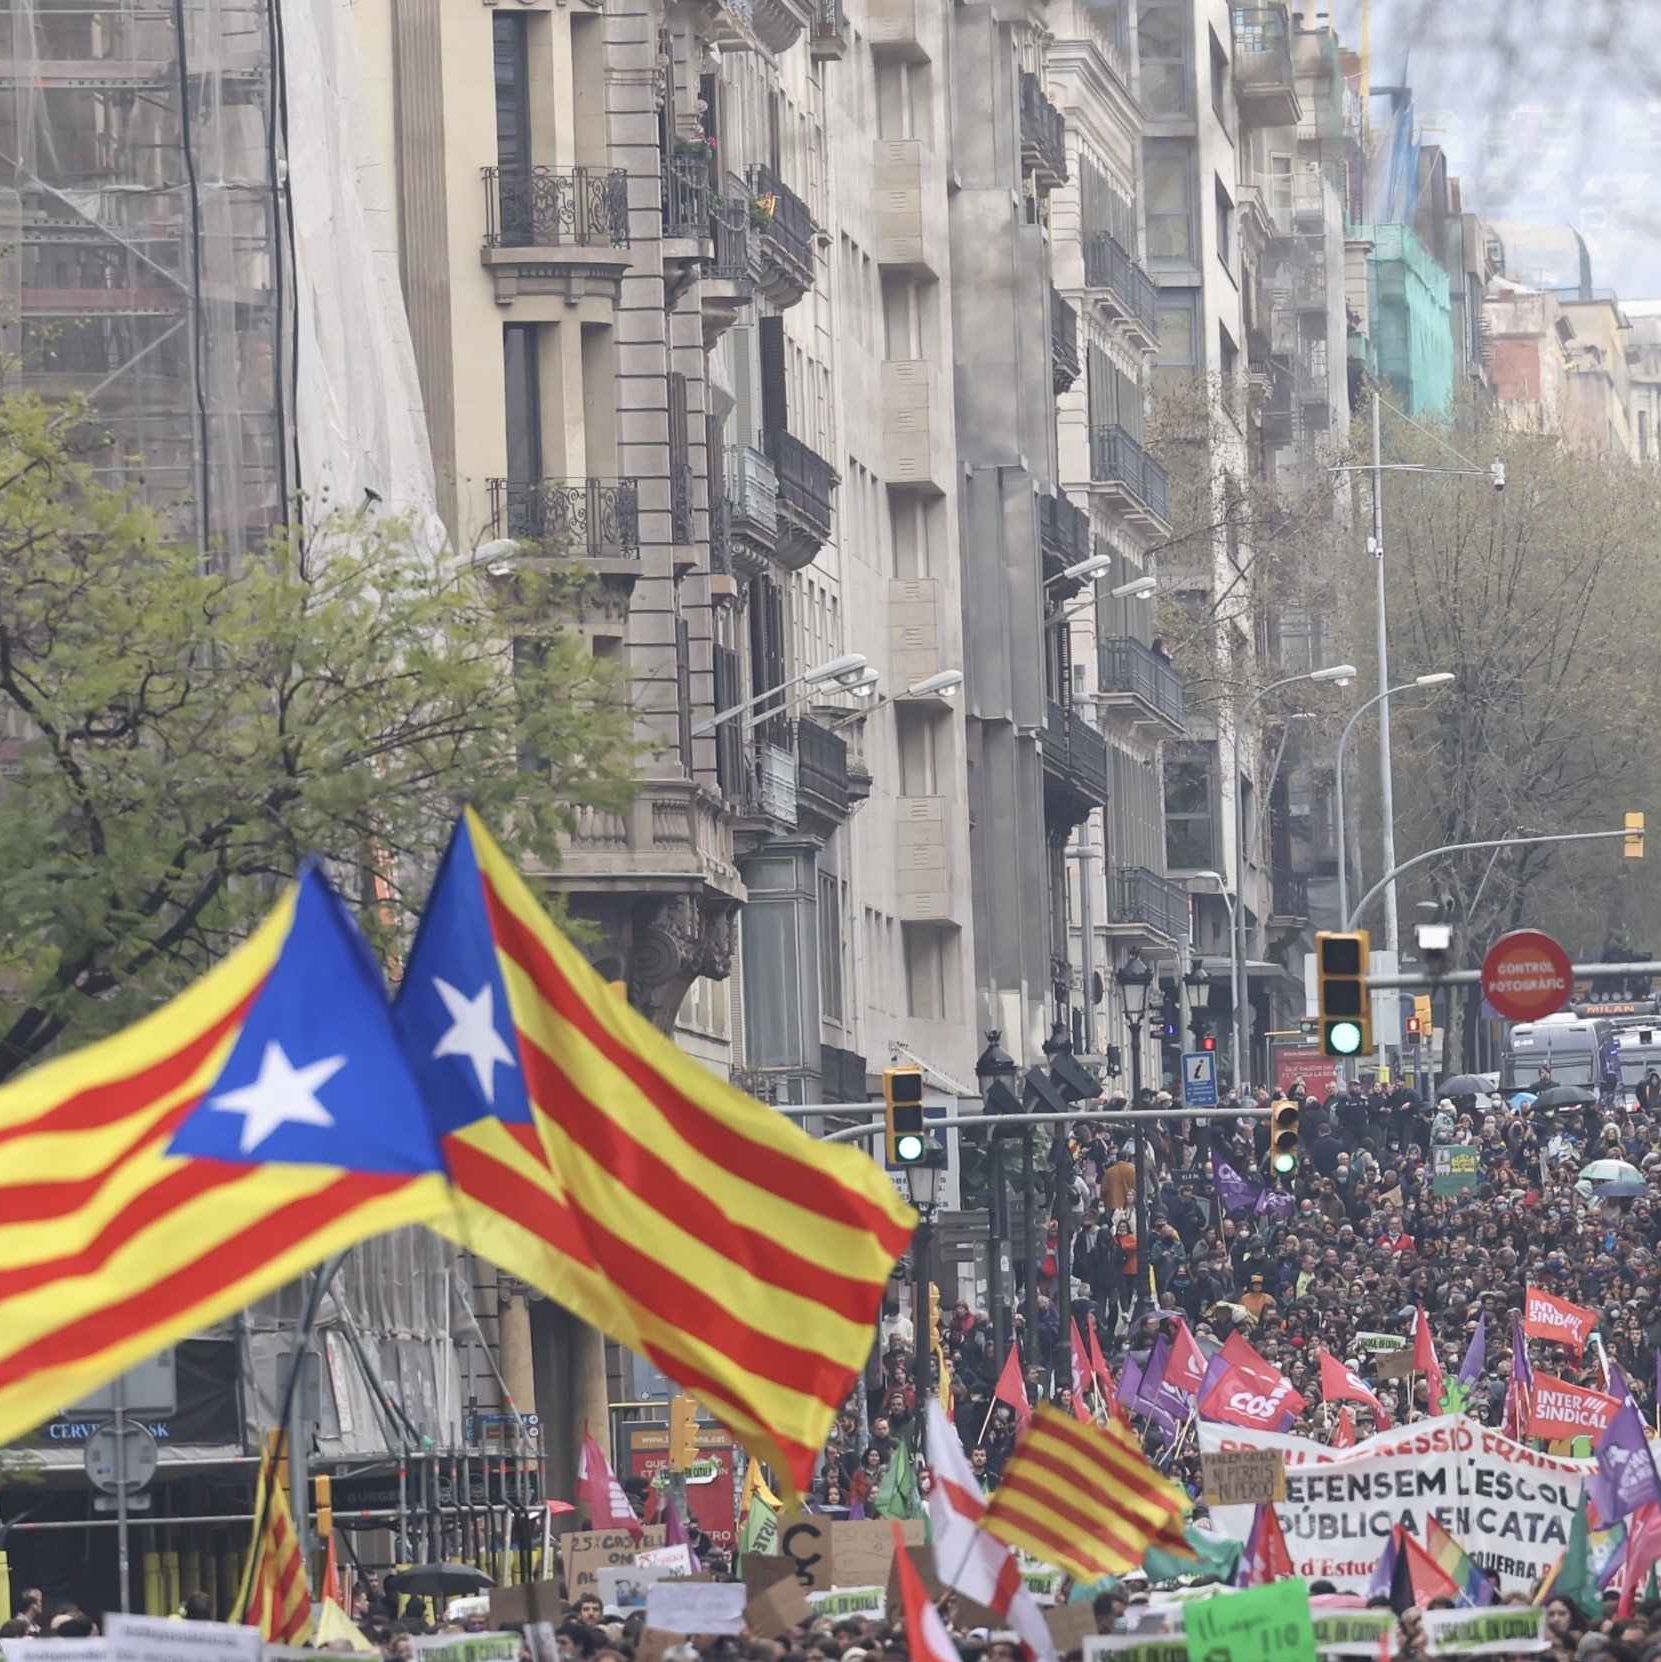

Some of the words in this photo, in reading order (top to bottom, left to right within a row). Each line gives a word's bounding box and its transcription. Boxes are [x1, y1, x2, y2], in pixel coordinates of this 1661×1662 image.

[1498, 962, 1555, 975] CONTROL
[1586, 1004, 1635, 1015] MILAN
[1229, 1391, 1282, 1419] COS
[1537, 1390, 1582, 1410] INTER
[1535, 1405, 1609, 1430] SINDICAL
[645, 1460, 667, 1469] QUE
[1227, 1464, 1275, 1481] PERMIS
[1285, 1467, 1446, 1504] EFENSEM
[1455, 1457, 1578, 1513] L'ESCOL
[1476, 1507, 1567, 1546] CATA
